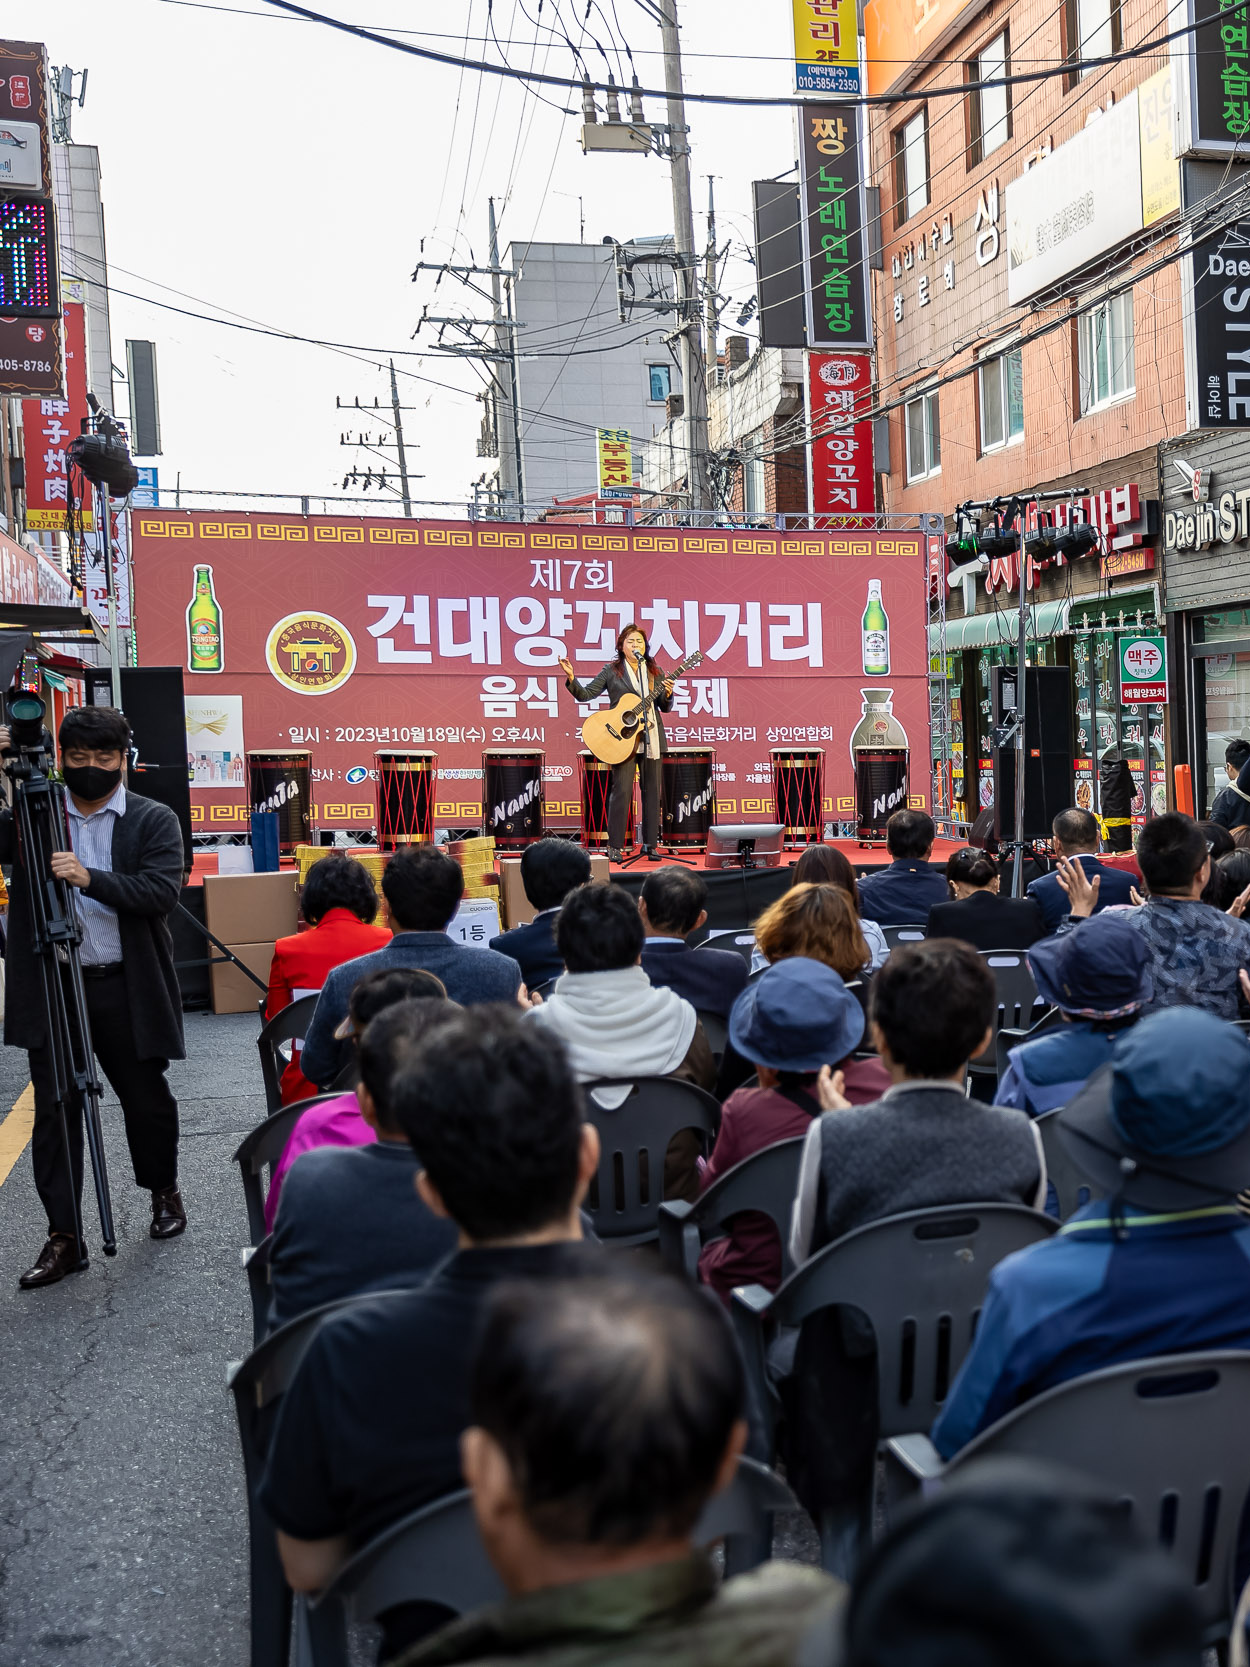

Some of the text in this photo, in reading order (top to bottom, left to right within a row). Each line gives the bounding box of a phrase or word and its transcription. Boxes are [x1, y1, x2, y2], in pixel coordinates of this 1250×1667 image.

[816, 50, 840, 62] 2F
[798, 76, 858, 91] 010-5854-2350
[811, 118, 848, 155] 짱
[817, 166, 854, 333] 노래연습장
[1165, 505, 1214, 551] Daejin
[529, 559, 615, 593] 제7회
[1128, 650, 1159, 666] 맥주
[479, 675, 559, 719] 음식
[1123, 687, 1166, 699] 해월양꼬치
[288, 727, 320, 743] 일시
[492, 726, 545, 743] 오후4시
[766, 725, 833, 743] 상인연합회
[459, 924, 486, 941] 1등
